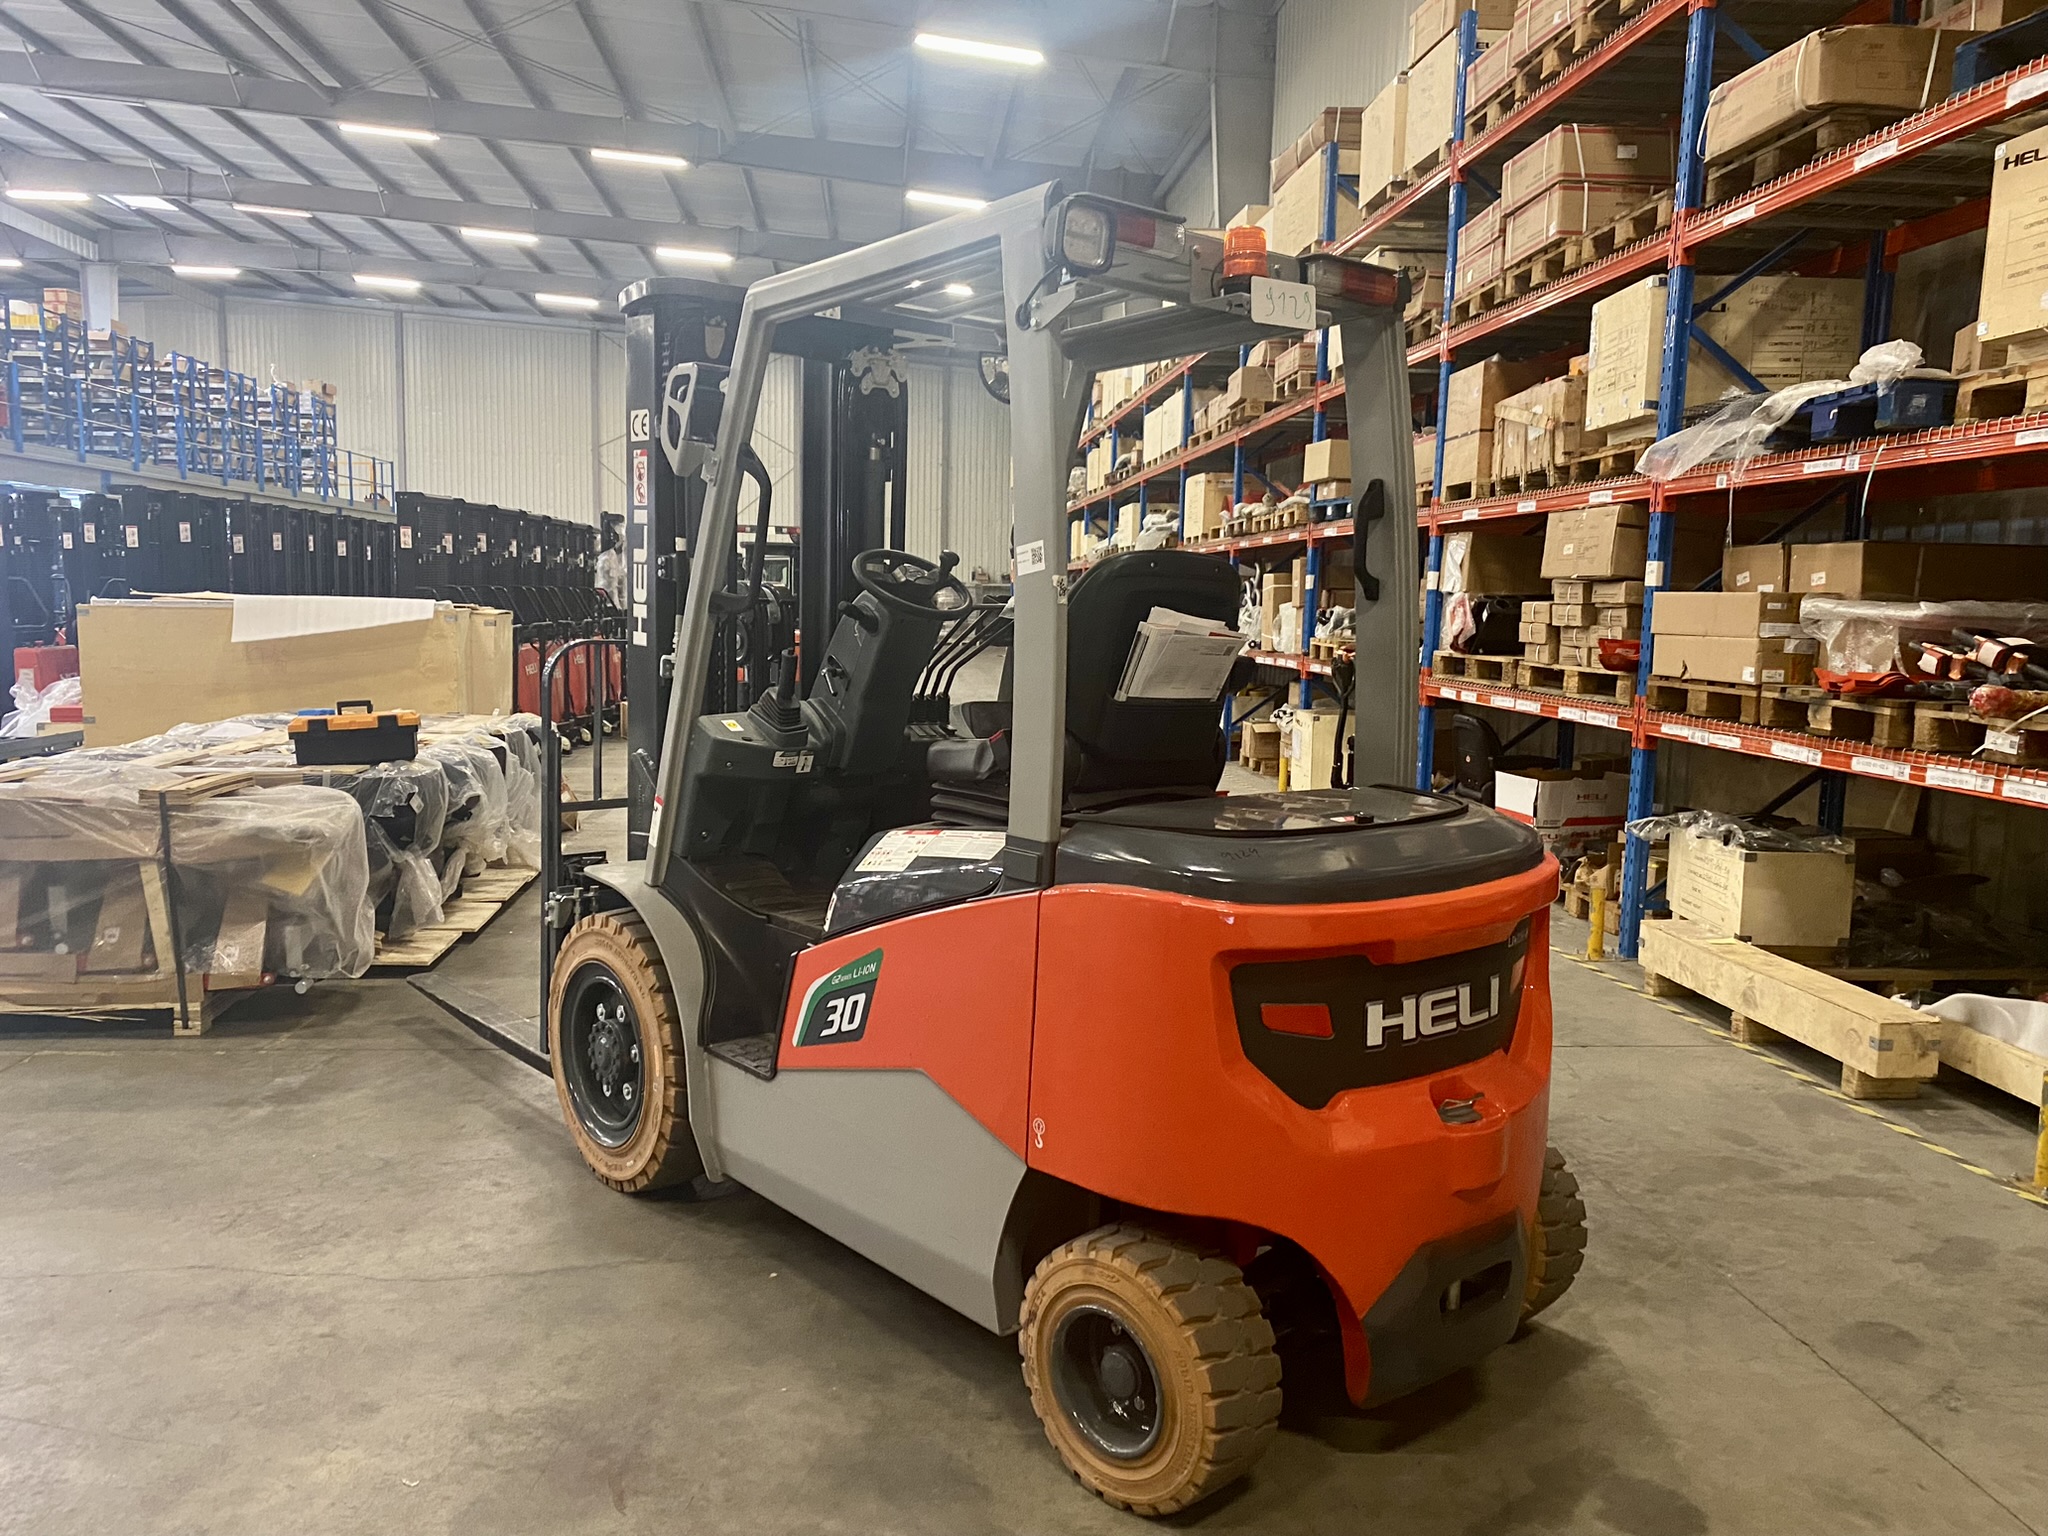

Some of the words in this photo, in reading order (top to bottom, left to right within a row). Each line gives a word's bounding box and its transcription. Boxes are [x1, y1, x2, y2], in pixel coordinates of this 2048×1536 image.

[2003, 148, 2048, 171] HEL
[632, 413, 648, 438] CE
[632, 509, 648, 647] HELI
[820, 992, 866, 1037] 30
[1364, 975, 1500, 1051] HELI
